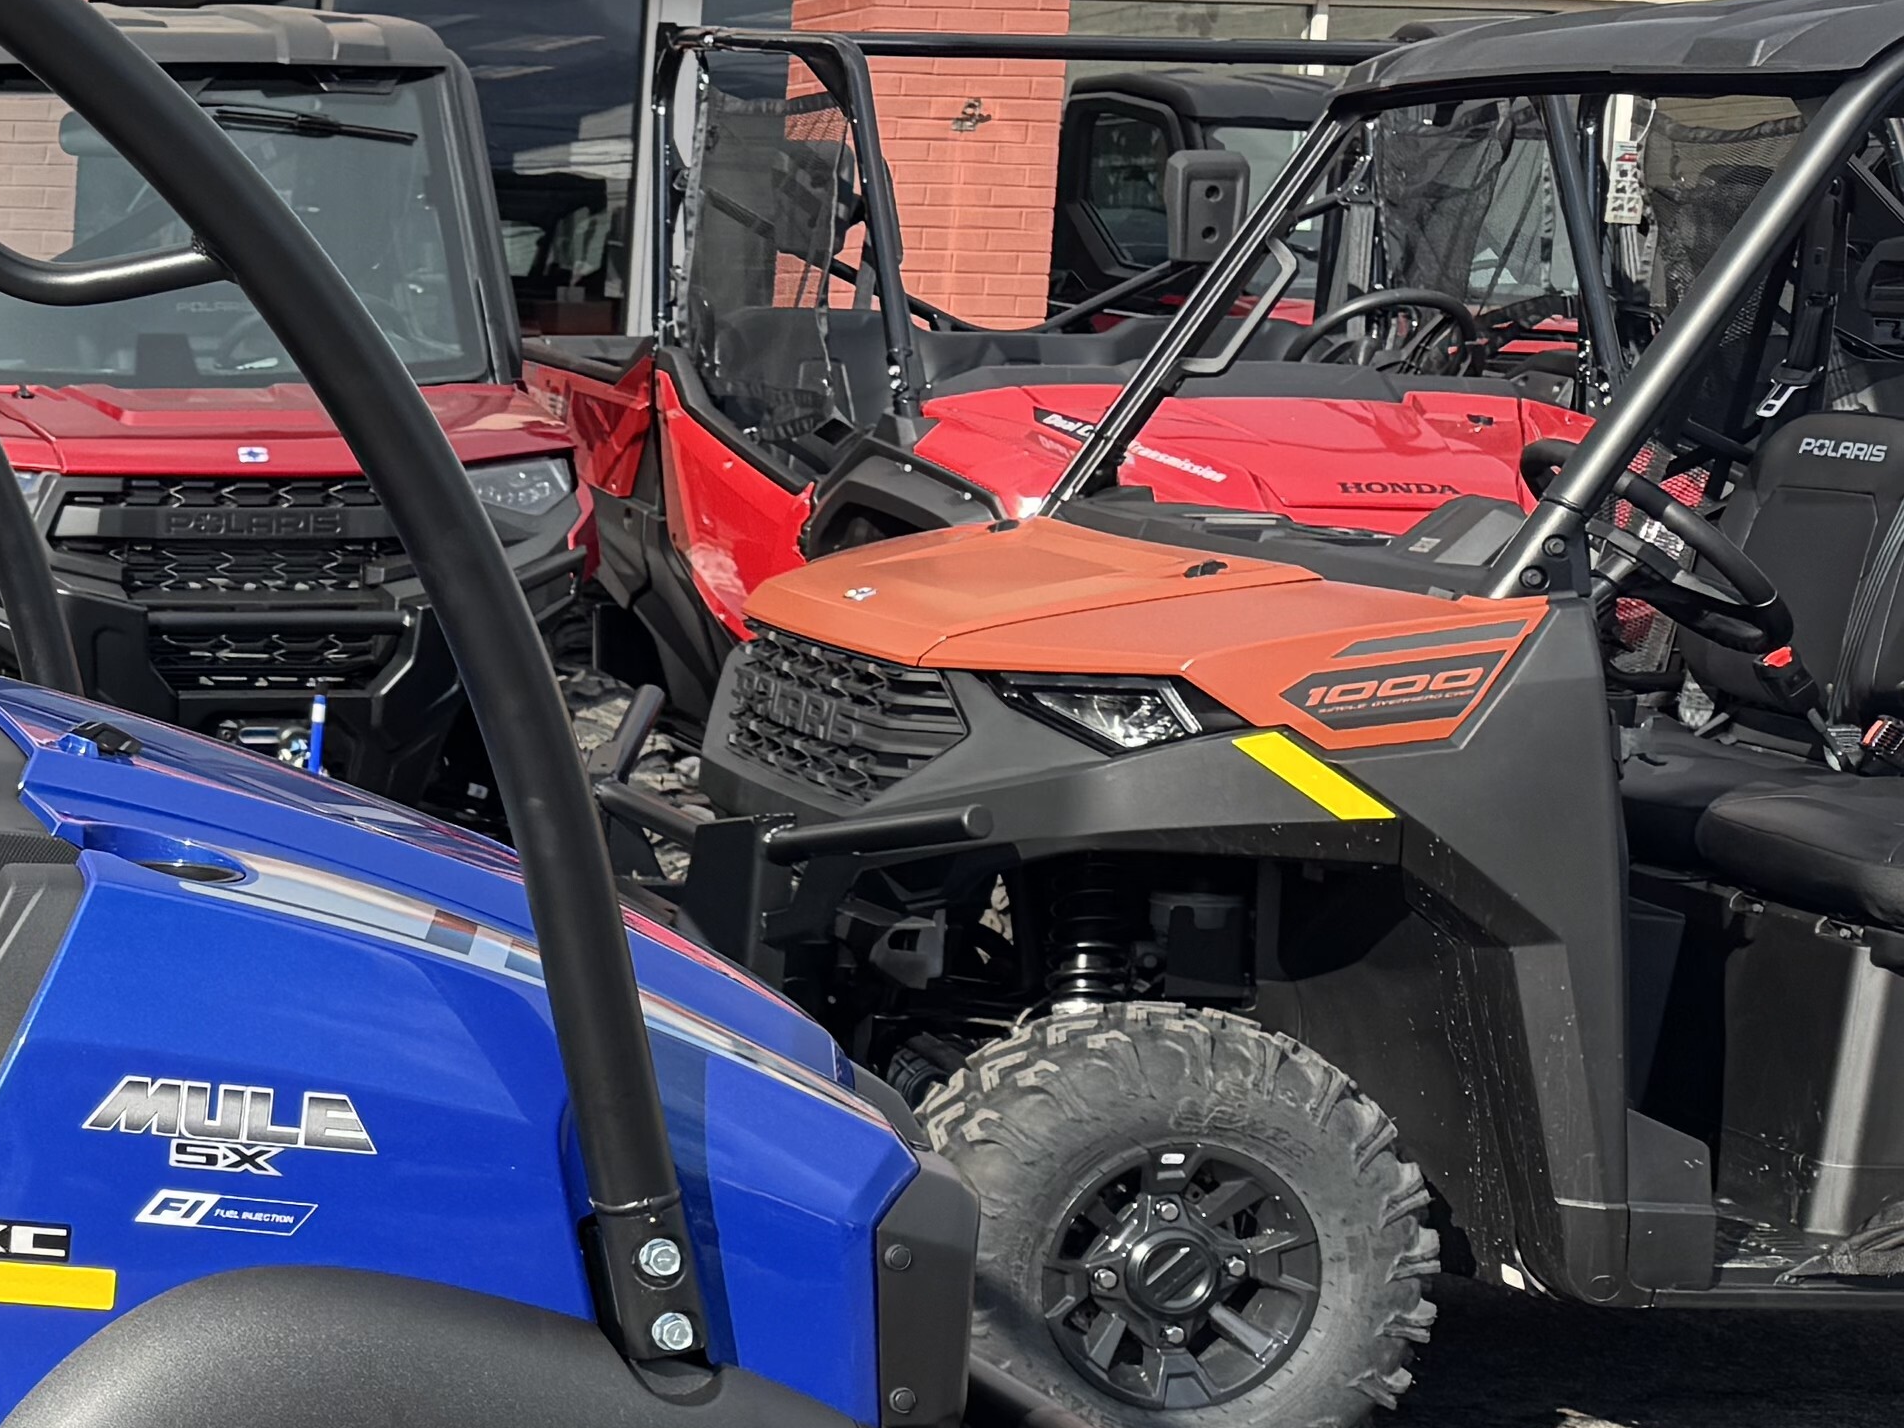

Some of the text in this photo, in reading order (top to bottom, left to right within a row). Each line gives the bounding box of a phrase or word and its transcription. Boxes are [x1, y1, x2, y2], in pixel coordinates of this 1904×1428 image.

[1798, 437, 1888, 463] POLARIS
[1339, 480, 1462, 496] HONDA
[165, 512, 342, 537] POLARIS
[1305, 666, 1484, 707] 1000
[81, 1074, 379, 1155] MULE
[170, 1139, 284, 1177] SX
[148, 1196, 207, 1219] FI
[213, 1207, 295, 1224] FUEL INJECTION
